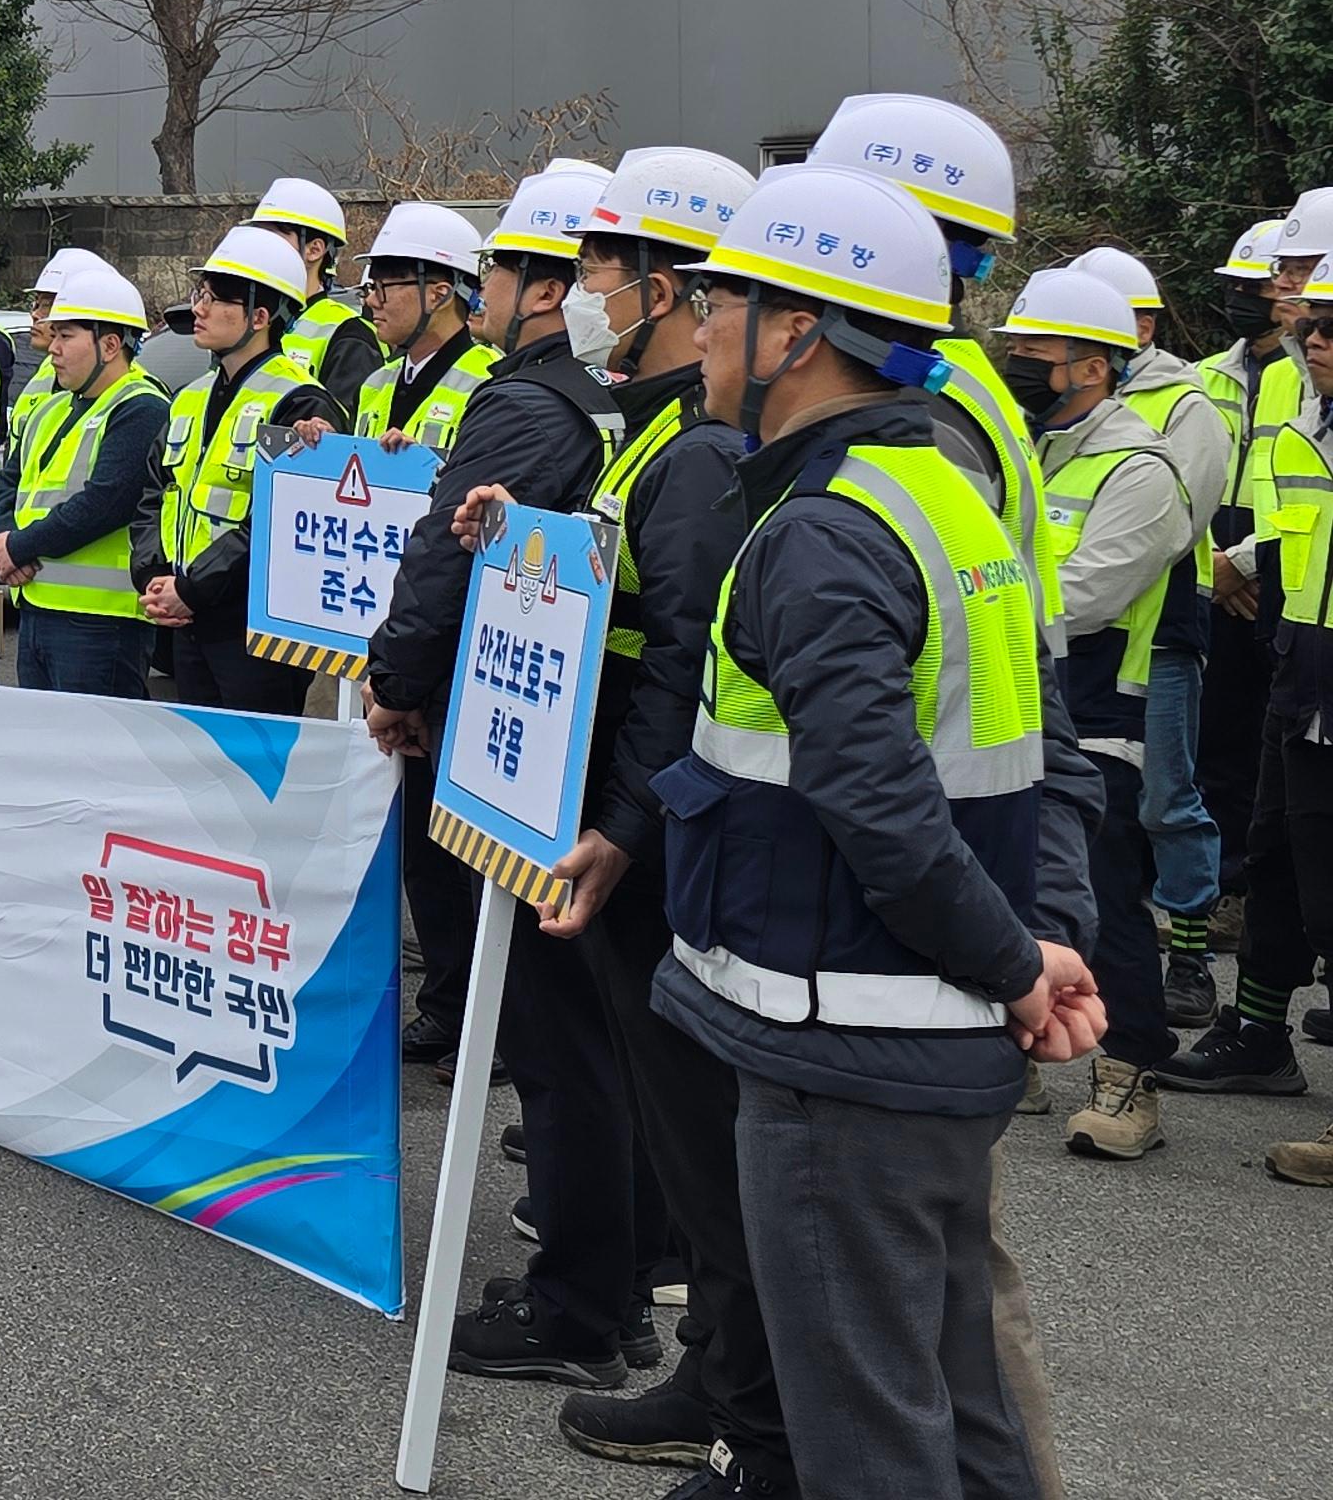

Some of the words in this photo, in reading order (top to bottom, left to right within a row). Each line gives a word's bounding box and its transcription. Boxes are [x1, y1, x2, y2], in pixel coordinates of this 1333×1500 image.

[320, 569, 377, 617] 준수
[474, 623, 565, 709] 안전보호구
[487, 706, 524, 778] 착용
[82, 873, 114, 923] 일
[120, 881, 215, 954] 잘하는
[227, 908, 290, 972] 정부
[86, 930, 111, 983] 더
[123, 941, 215, 1018] 편안한
[225, 973, 290, 1040] 국민
